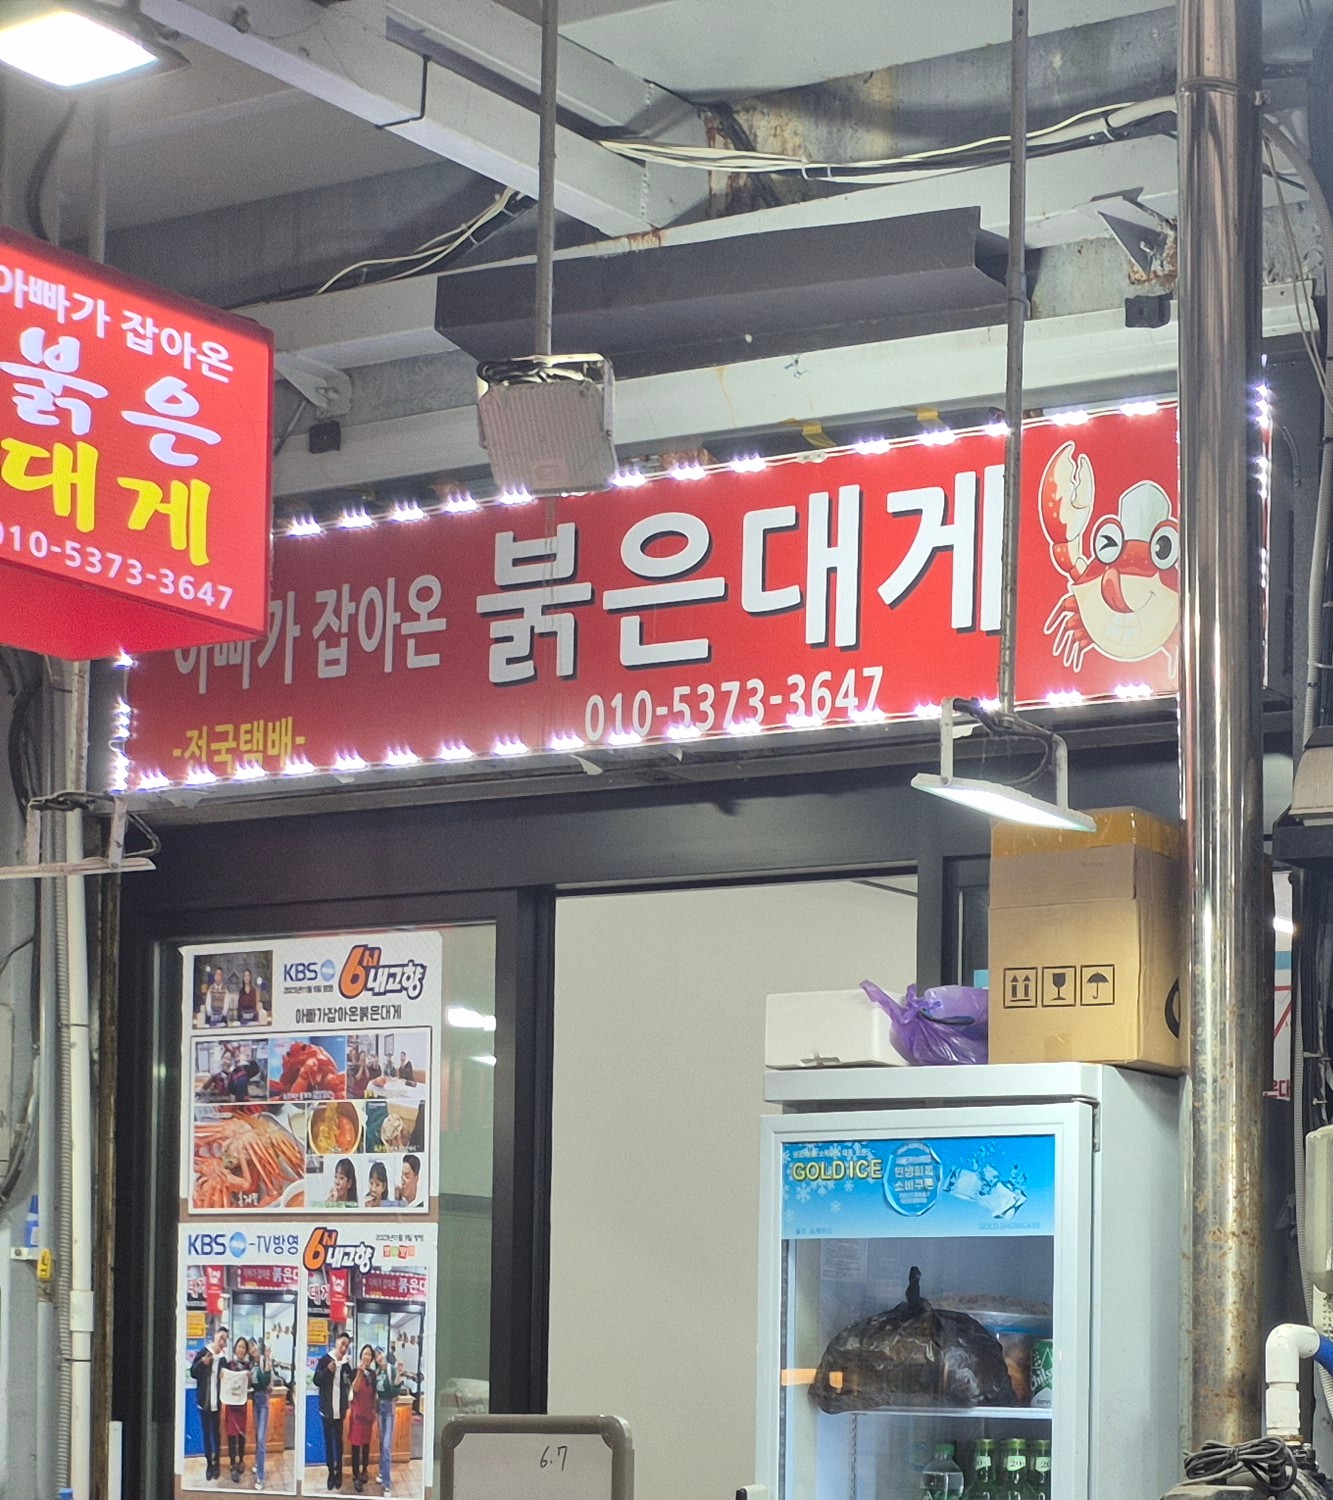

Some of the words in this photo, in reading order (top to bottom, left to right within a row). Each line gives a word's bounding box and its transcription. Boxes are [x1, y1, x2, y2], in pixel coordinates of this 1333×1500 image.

[0, 262, 110, 338] 아빠가
[120, 309, 234, 383] 잡아온
[313, 575, 448, 679] 잡아온
[476, 464, 1003, 685] 붉은대게
[585, 665, 883, 741] 010-5373-3647
[284, 962, 318, 982] KBS
[188, 1234, 226, 1256] KBS
